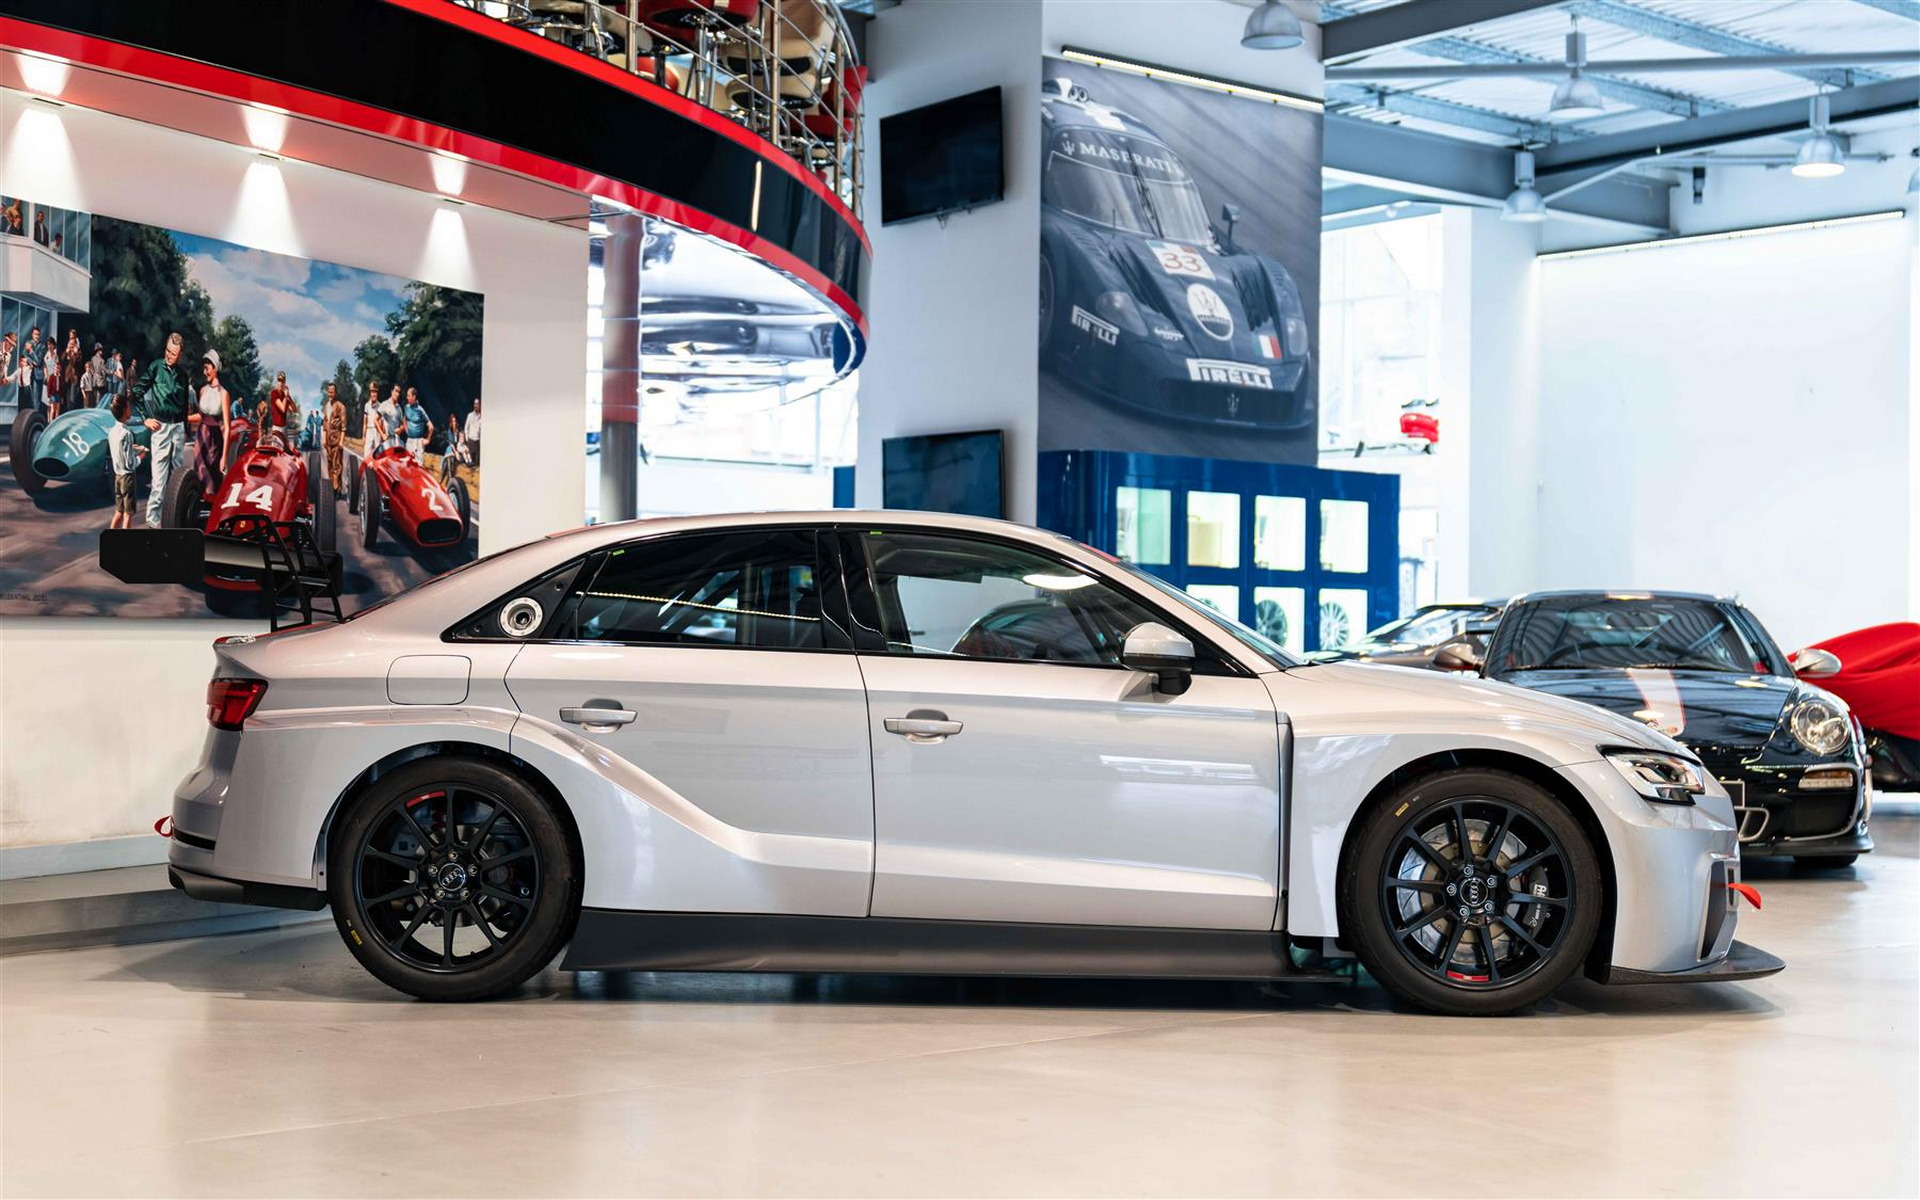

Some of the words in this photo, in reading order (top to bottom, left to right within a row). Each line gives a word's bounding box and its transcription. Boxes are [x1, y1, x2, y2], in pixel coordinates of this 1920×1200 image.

[1079, 141, 1172, 173] MASERATI
[1162, 252, 1202, 273] 33
[1186, 358, 1273, 389] PIRELLI
[62, 432, 90, 457] 18
[221, 482, 273, 512] 14
[421, 488, 444, 511] 2
